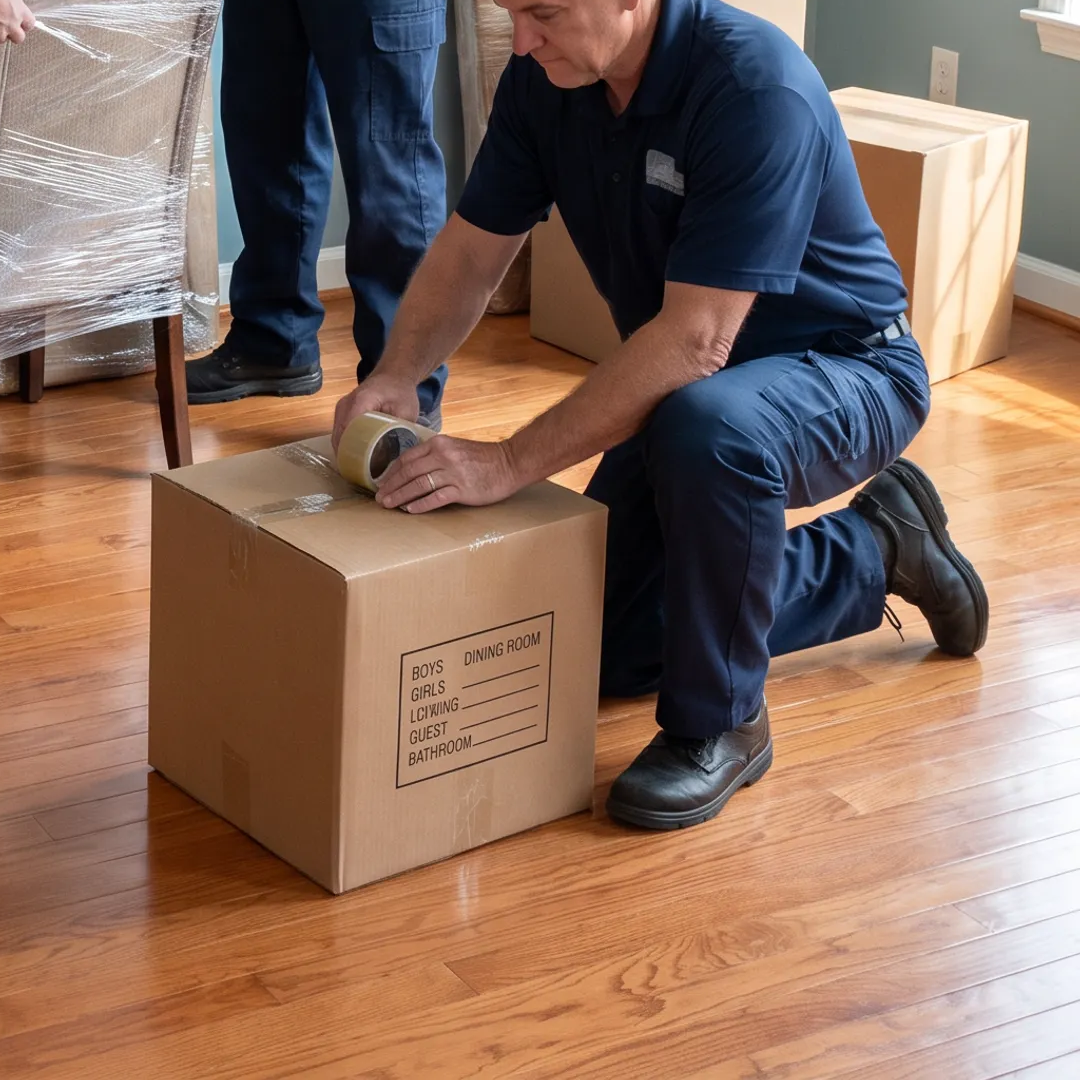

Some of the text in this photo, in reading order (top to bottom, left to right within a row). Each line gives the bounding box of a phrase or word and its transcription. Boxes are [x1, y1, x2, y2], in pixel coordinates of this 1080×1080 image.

[464, 631, 541, 667] DINING ROOM
[412, 659, 444, 682] BOYS
[411, 680, 446, 703] GIRLS
[409, 720, 448, 745] GUEST
[408, 734, 472, 767] BATHROOM
